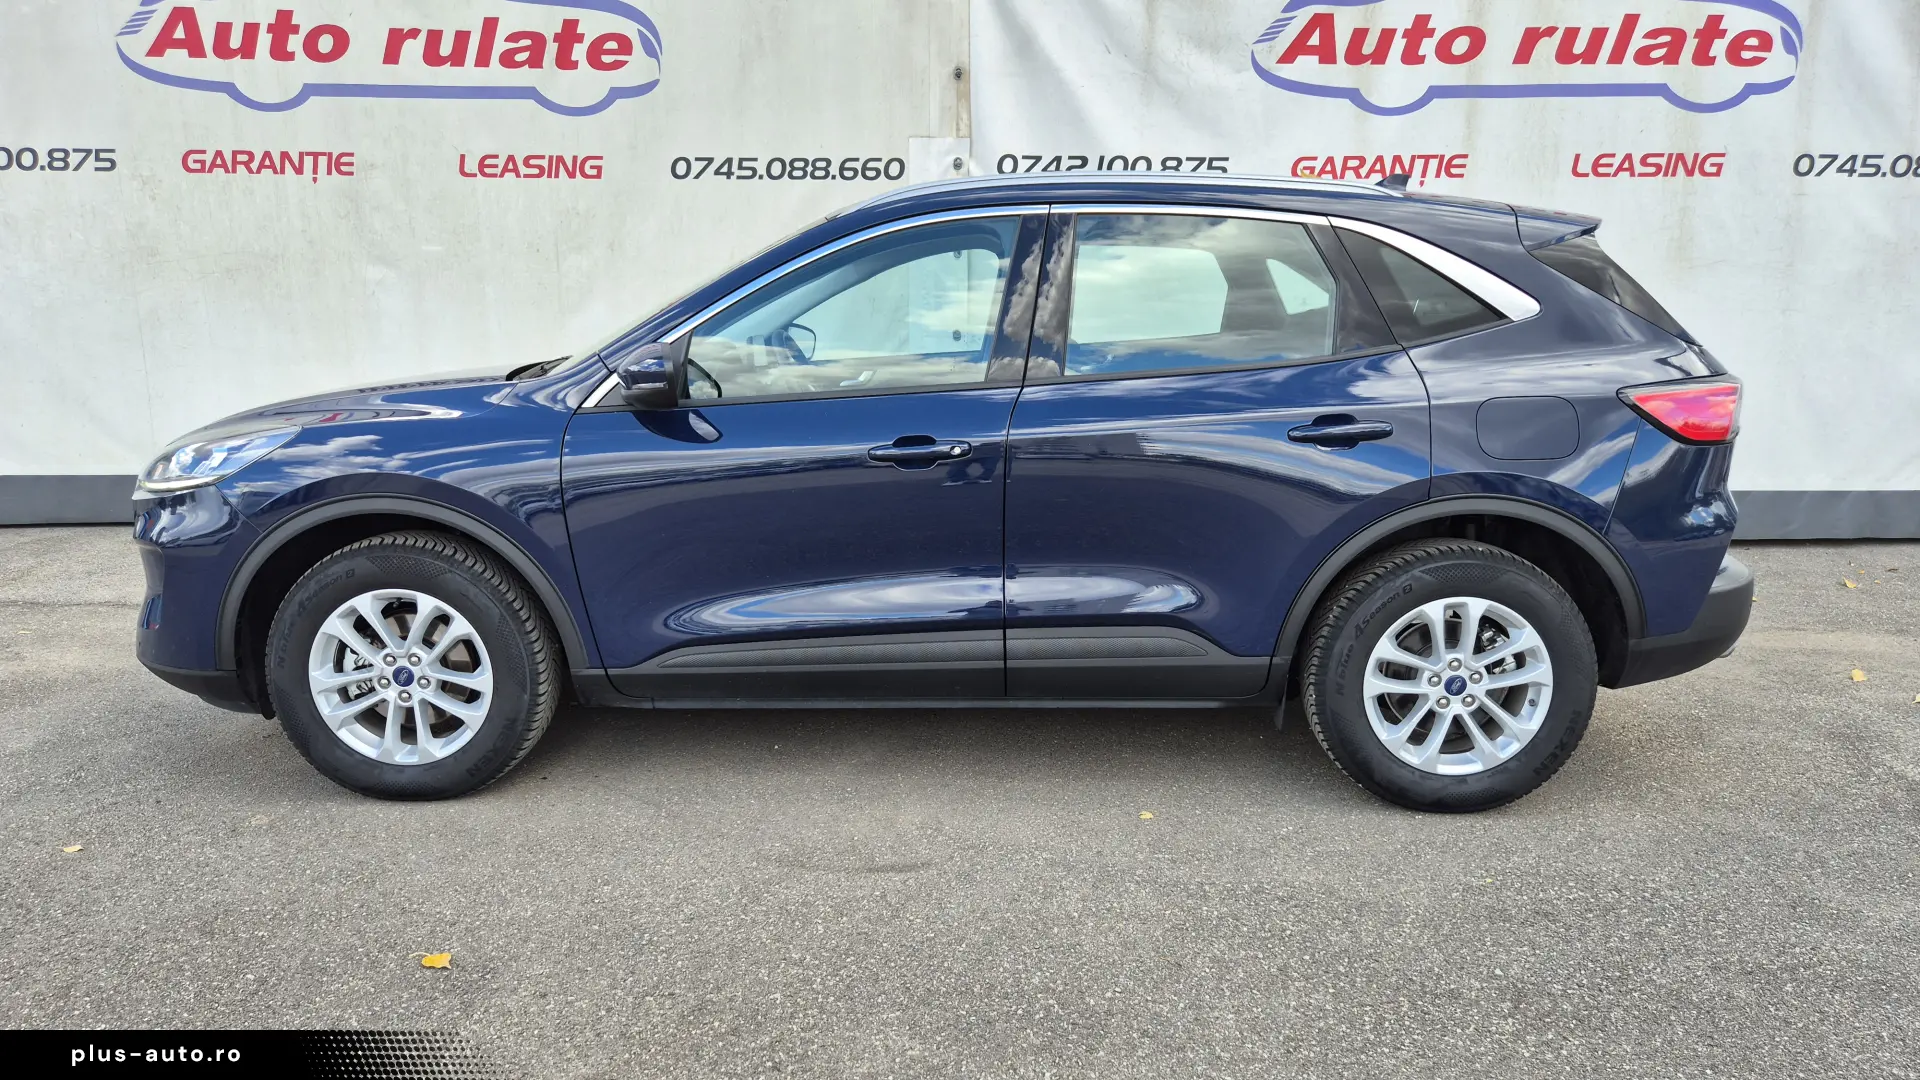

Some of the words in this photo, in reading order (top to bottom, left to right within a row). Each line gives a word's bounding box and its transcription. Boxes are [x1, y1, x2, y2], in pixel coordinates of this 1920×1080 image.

[146, 7, 351, 63] Auto
[382, 17, 634, 72] rulate
[1276, 13, 1487, 67] Auto
[1512, 14, 1774, 67] rulate
[459, 155, 603, 180] LEASING
[670, 156, 906, 181] 0745.088.660
[1571, 153, 1726, 178] LEASING
